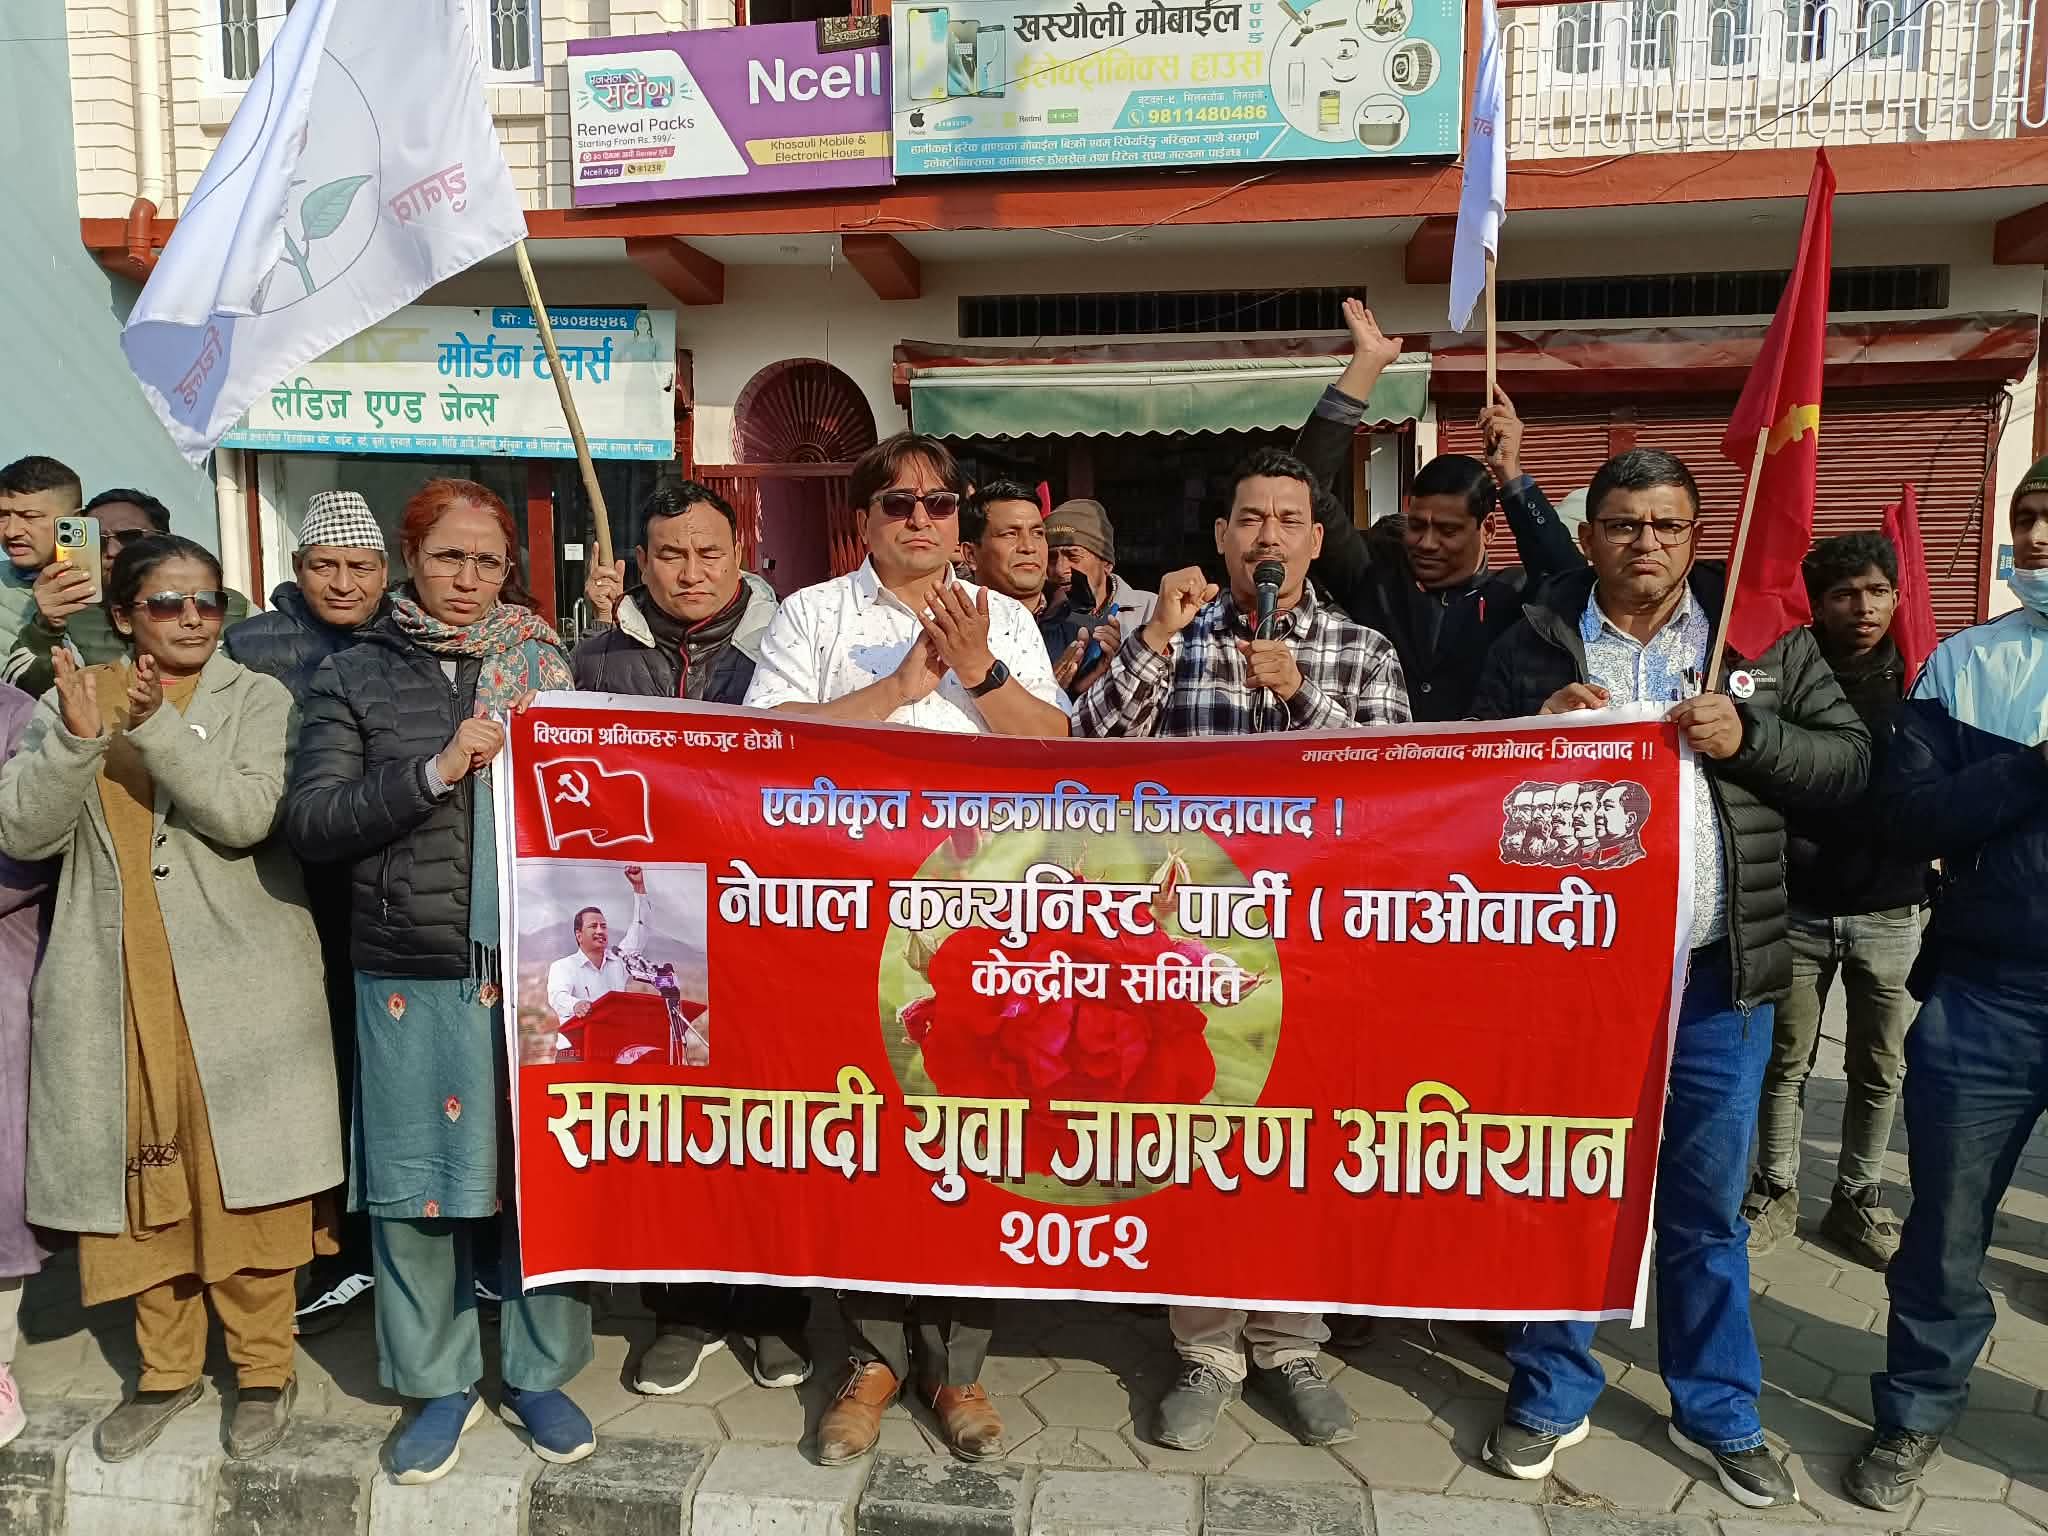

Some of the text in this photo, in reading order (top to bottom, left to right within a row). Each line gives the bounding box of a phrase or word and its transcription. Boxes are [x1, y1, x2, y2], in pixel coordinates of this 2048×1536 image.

[1014, 0, 1242, 42] खस्यौली मोबाईल
[749, 52, 881, 104] Ncell
[1190, 52, 1263, 82] हाउस
[647, 81, 673, 96] ON
[577, 116, 695, 136] Renewal Packs
[1148, 105, 1267, 123] 9811480486
[578, 140, 611, 148] Starting
[819, 135, 855, 147] Mobile
[858, 135, 866, 144] &
[775, 148, 865, 162] Electronic House
[604, 167, 619, 177] App
[271, 376, 499, 428] लेडिज एण्ड जेन्स
[1752, 675, 1776, 683] mandu
[534, 722, 592, 744] विश्वका
[761, 776, 910, 840] एकीकृत
[717, 860, 874, 931] नेपाल
[888, 862, 1160, 950] कम्युनिस्ट
[1177, 869, 1293, 941] पार्टी
[971, 947, 1244, 1006] केन्द्रीय समिति
[547, 1065, 1634, 1202] समाजवादी युवा जागरण अभियान
[1000, 1210, 1149, 1271] २०८२
